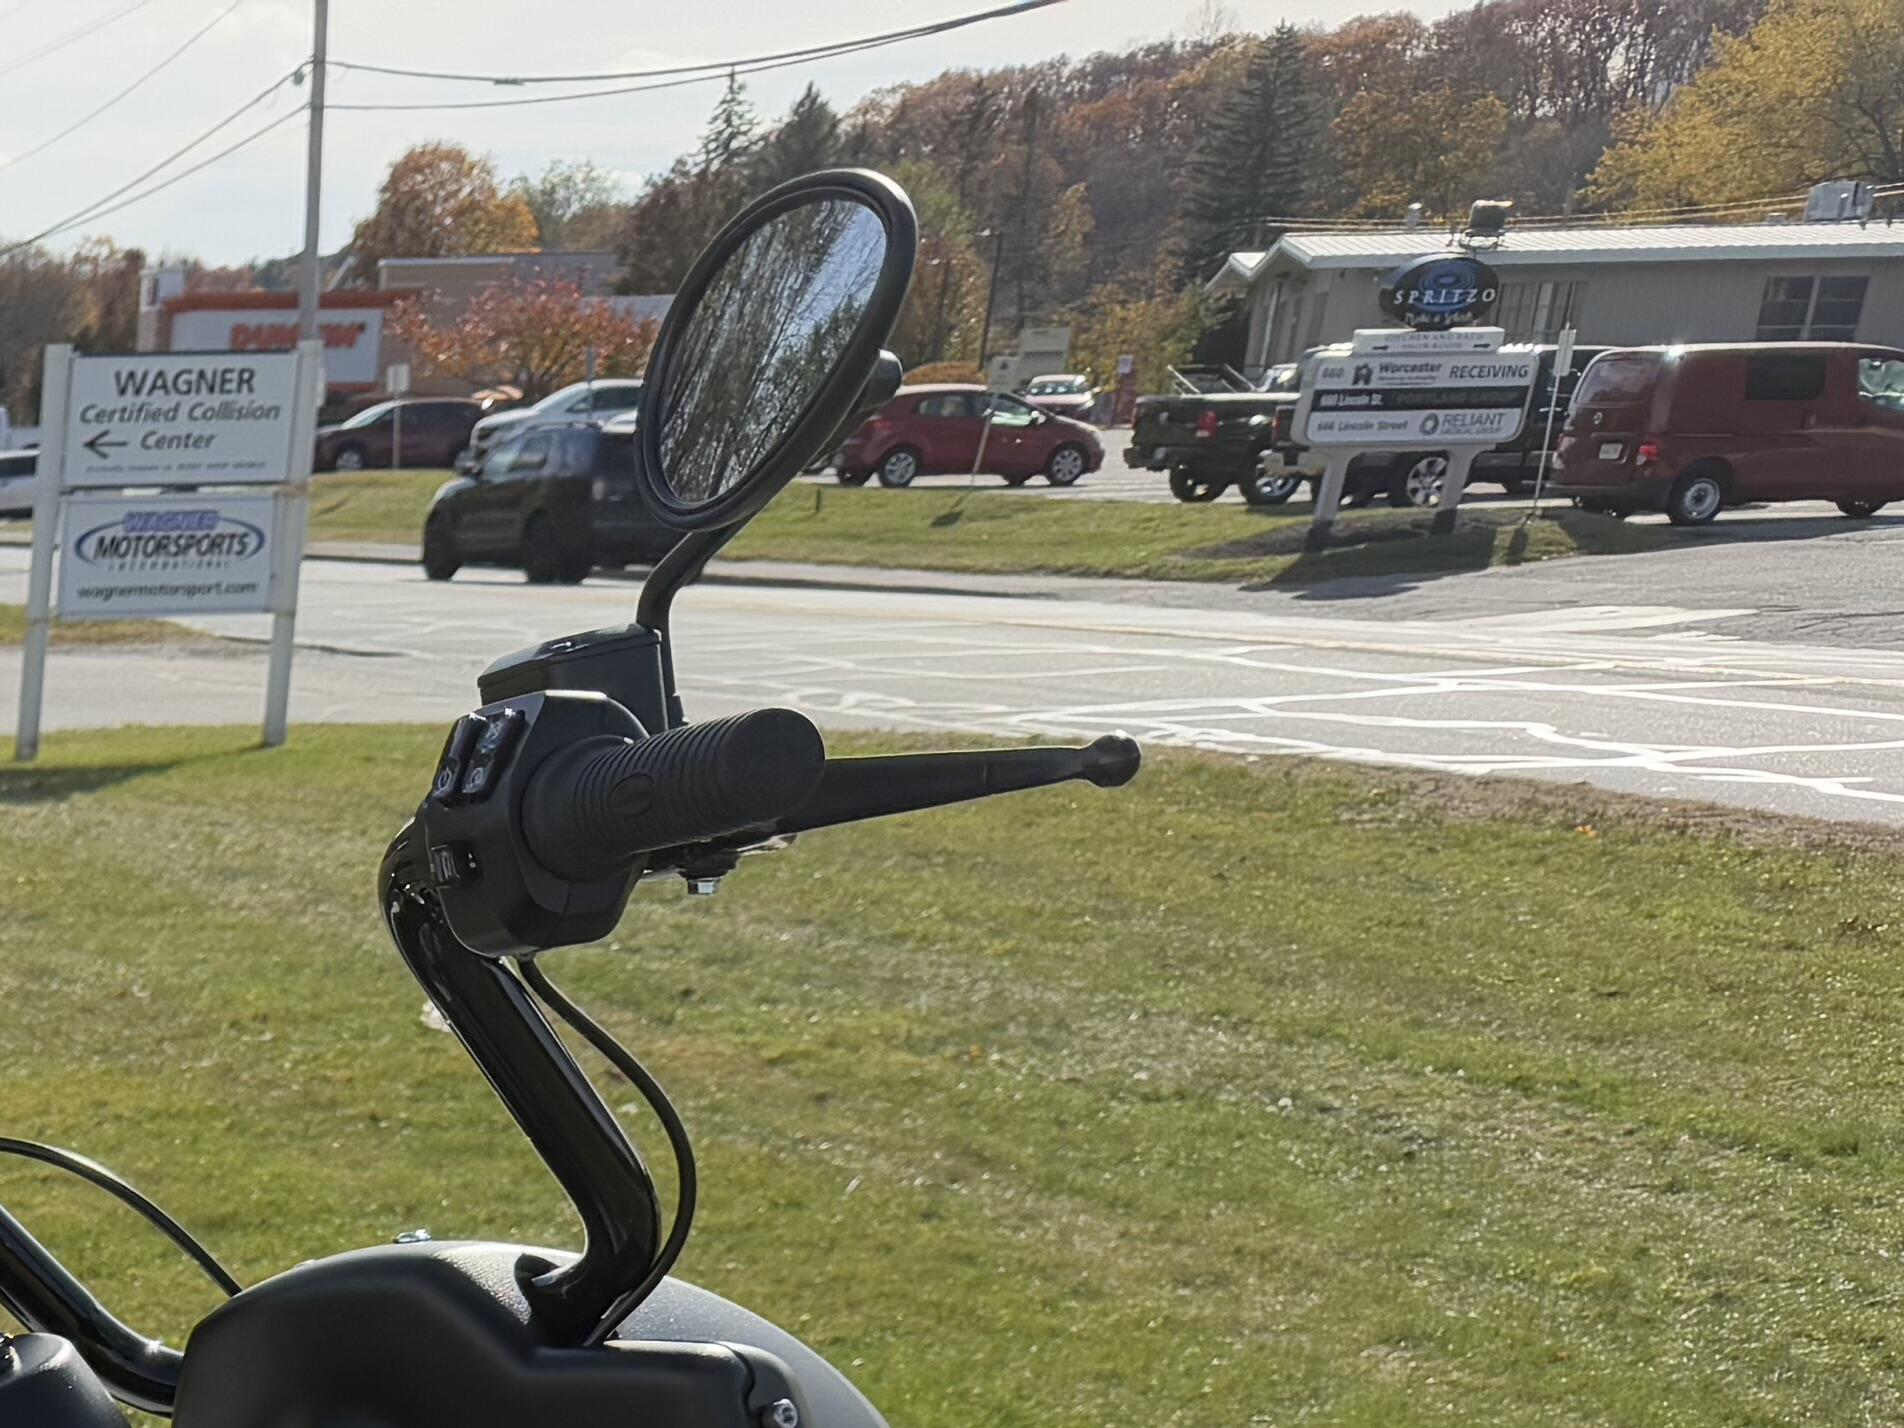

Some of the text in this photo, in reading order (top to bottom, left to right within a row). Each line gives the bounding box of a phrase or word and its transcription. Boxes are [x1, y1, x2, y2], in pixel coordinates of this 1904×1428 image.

[1394, 288, 1496, 305] SPRITZO
[1378, 361, 1443, 374] Worcester
[1449, 363, 1529, 379] RECEIVING
[114, 367, 257, 397] WAGNER
[79, 401, 281, 425] Certified Collision
[1442, 412, 1504, 428] RELIANT
[140, 429, 219, 451] Center
[124, 510, 220, 533] WAGNER
[94, 532, 249, 561] MOTORSPORTS
